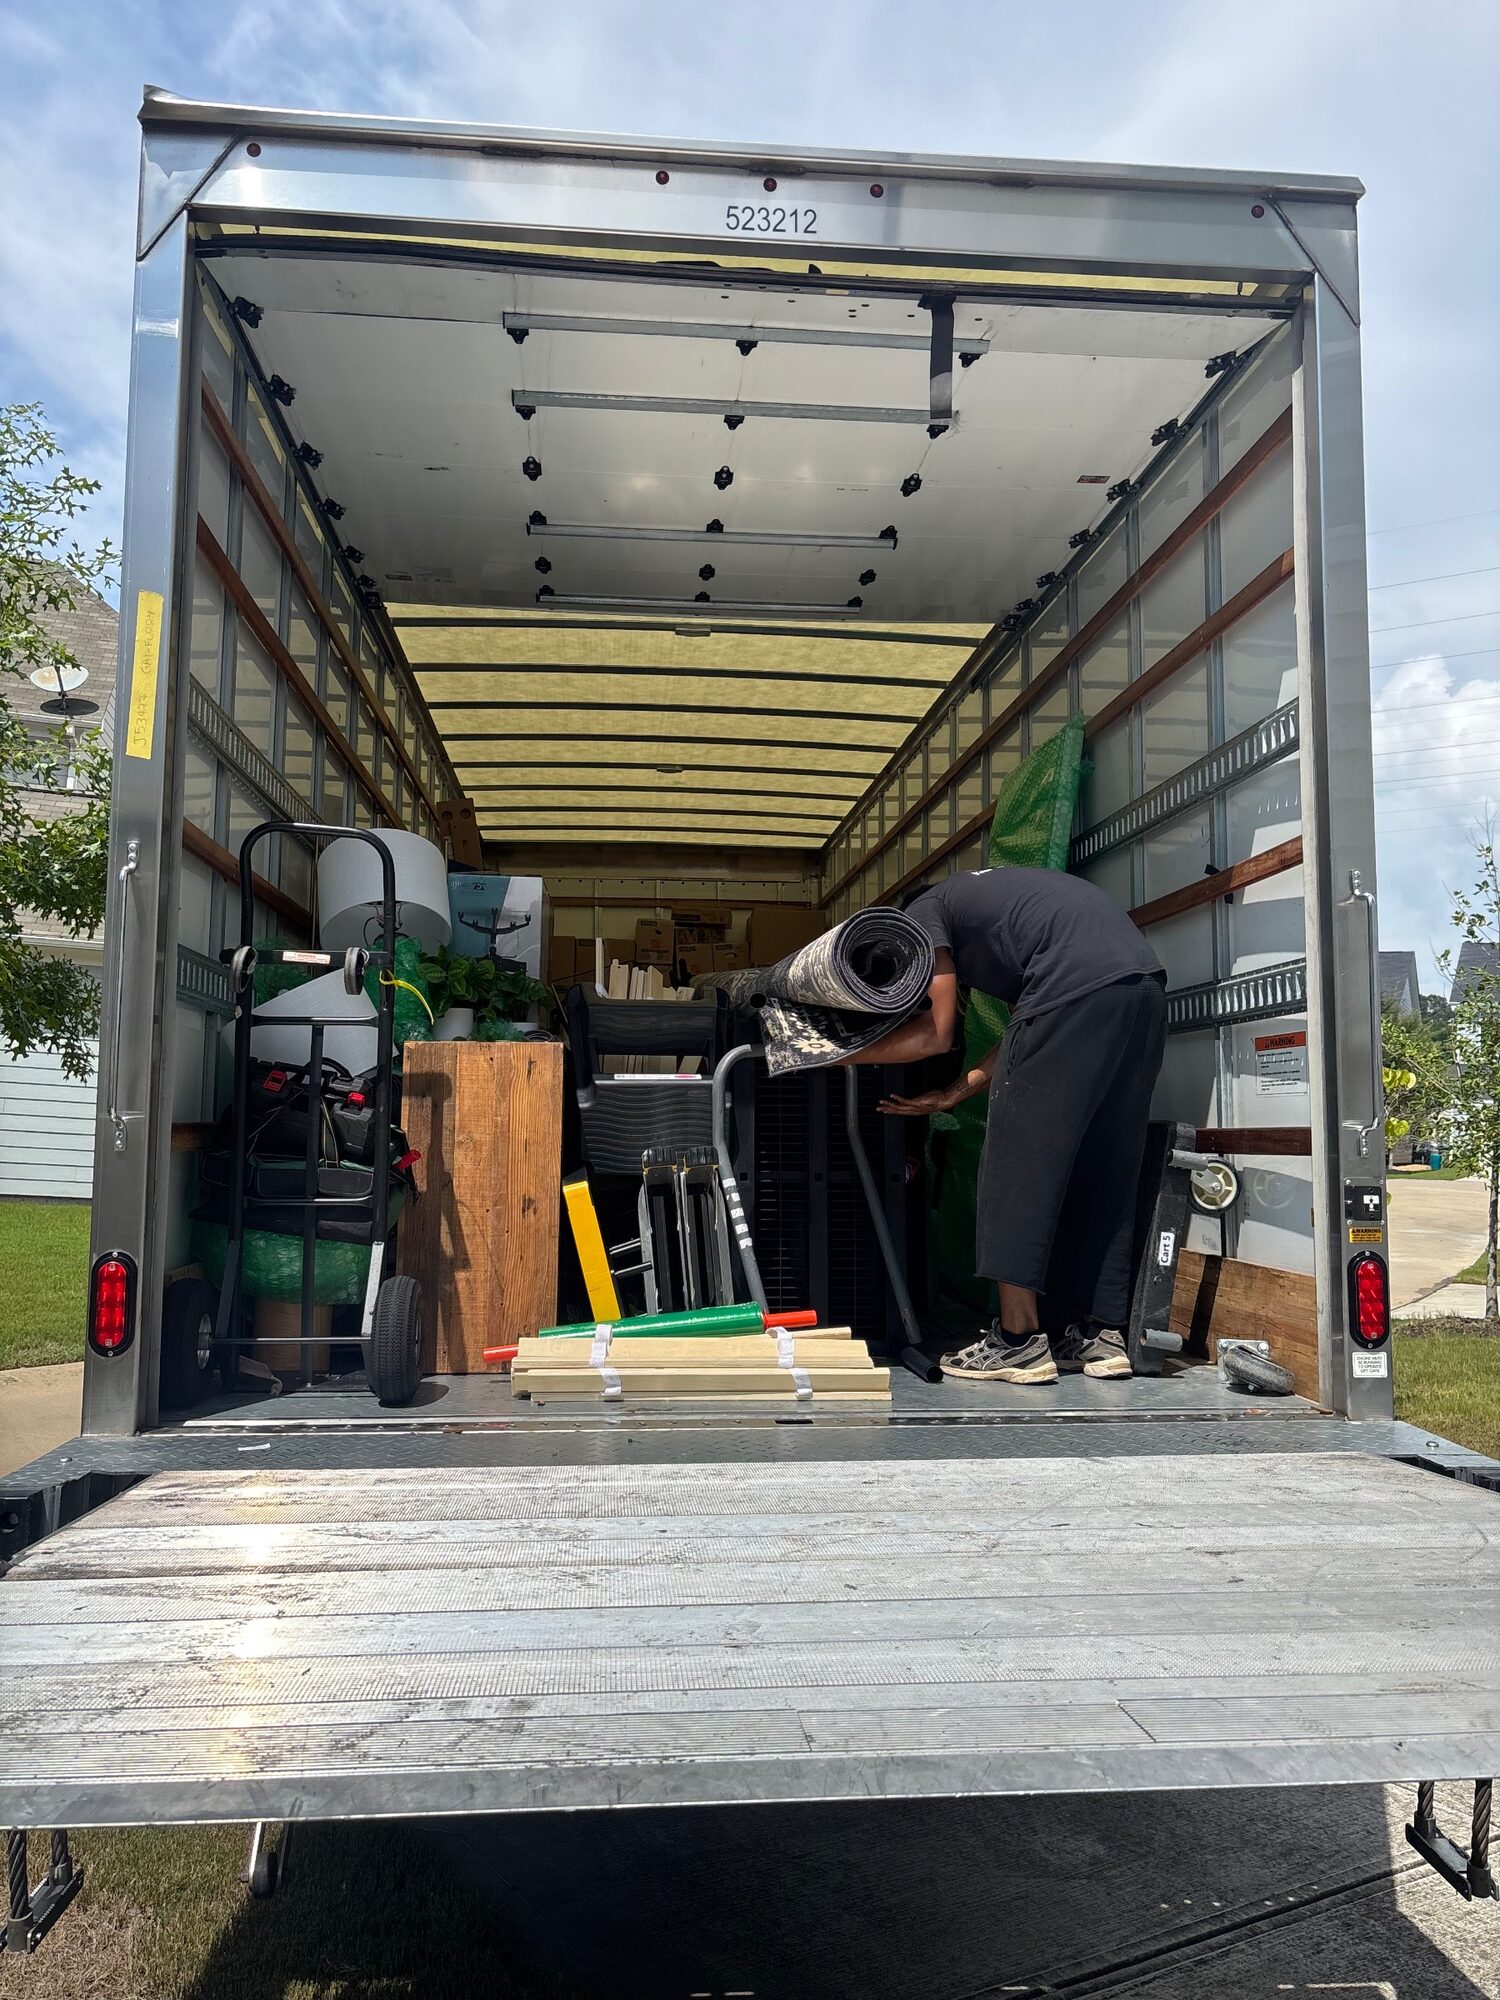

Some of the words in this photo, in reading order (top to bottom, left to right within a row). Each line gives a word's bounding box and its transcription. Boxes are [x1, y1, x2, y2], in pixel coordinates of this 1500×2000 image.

[726, 206, 817, 234] 523212
[1270, 1036, 1296, 1047] WARNING
[1161, 1243, 1170, 1263] Cart
